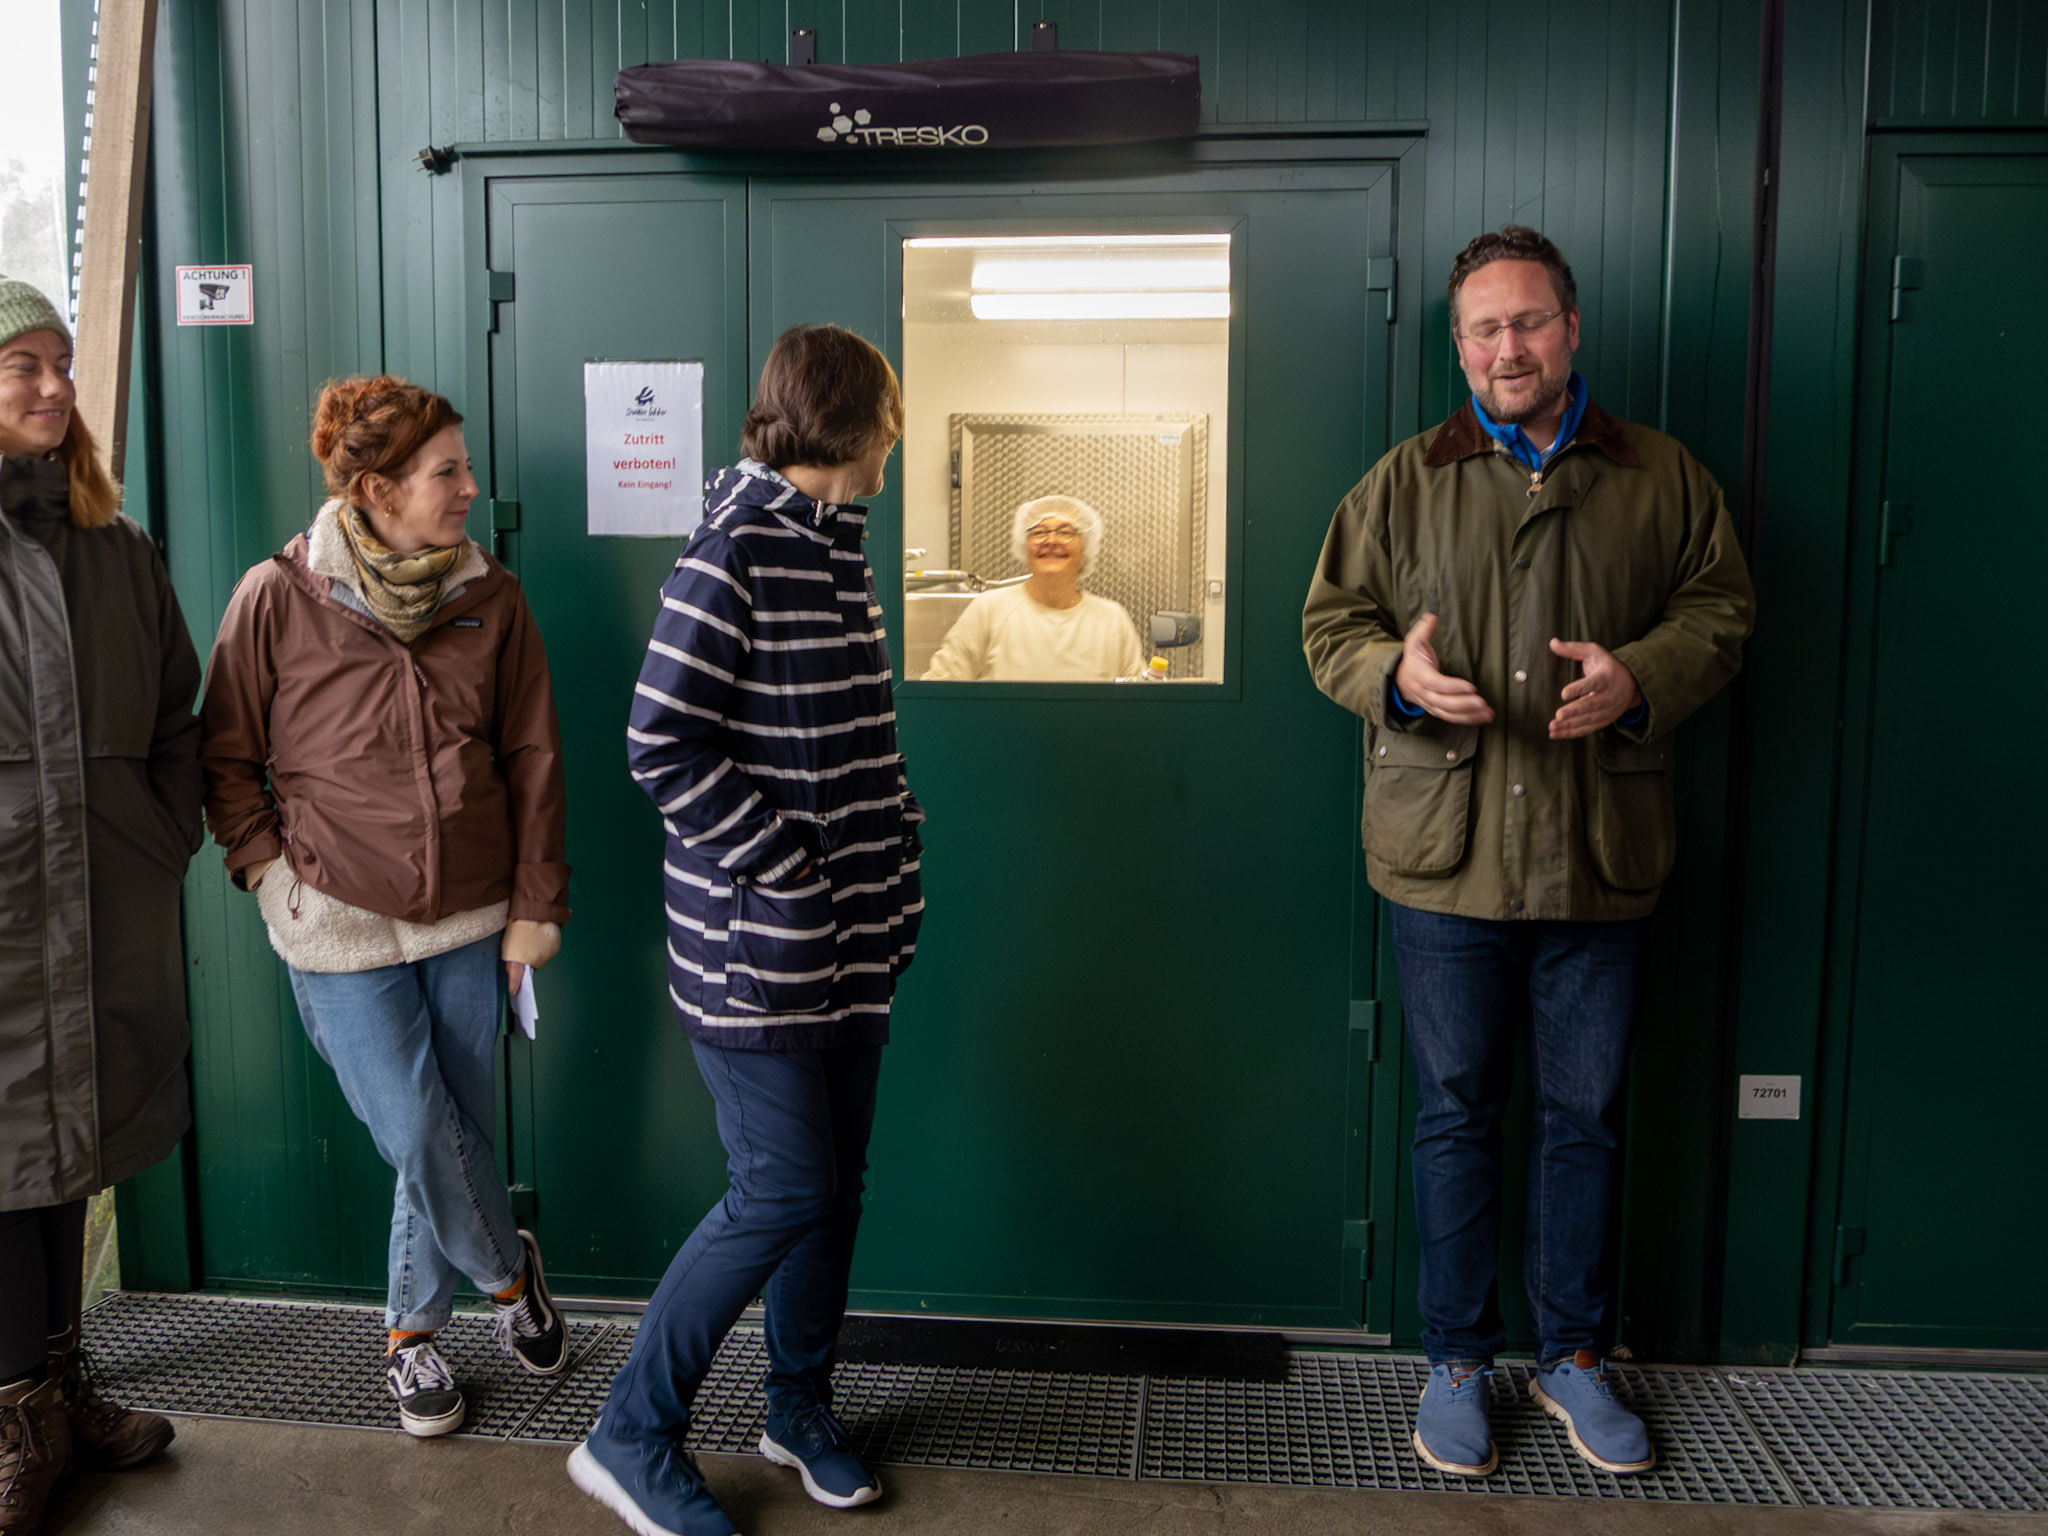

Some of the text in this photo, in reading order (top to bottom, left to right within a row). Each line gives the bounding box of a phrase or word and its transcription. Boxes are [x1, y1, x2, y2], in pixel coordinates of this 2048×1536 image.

[854, 125, 989, 146] TRESKO
[183, 270, 239, 280] ACHTUNG
[624, 433, 665, 445] Zutritt
[613, 457, 676, 470] verboten!
[638, 480, 672, 490] Eingang!
[1752, 1088, 1787, 1098] 72701
